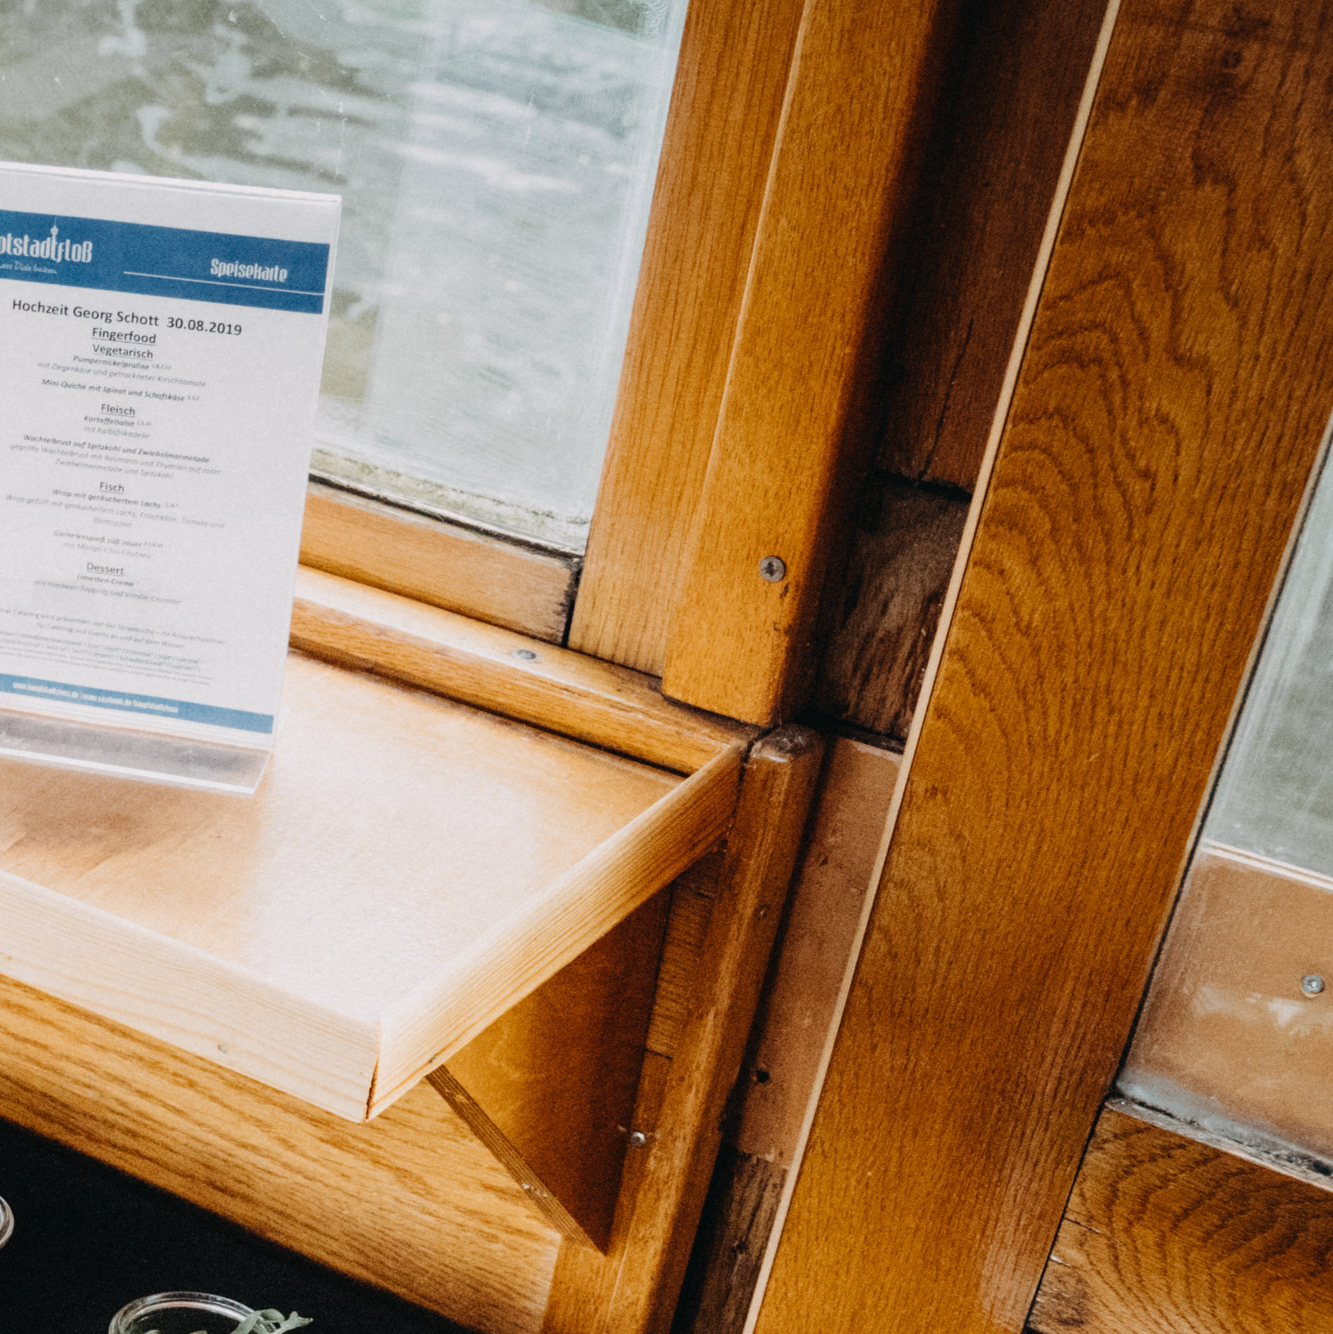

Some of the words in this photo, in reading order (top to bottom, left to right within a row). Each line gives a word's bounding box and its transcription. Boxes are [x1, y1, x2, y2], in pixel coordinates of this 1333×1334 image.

[210, 258, 288, 283] Speisekarte
[12, 298, 69, 317] Hochzeit
[72, 305, 113, 323] Georg
[116, 310, 160, 327] Schott
[166, 316, 243, 337] 30.08.2019
[91, 326, 157, 345] Fingerfood
[92, 343, 154, 359] Vegetarisch
[102, 386, 127, 395] Spinat
[100, 403, 136, 416] Fleisch
[83, 415, 135, 427] Kartoffelsalat
[121, 447, 137, 455] und
[99, 481, 125, 493] Fisch
[52, 488, 73, 498] Wrap
[140, 500, 161, 509] Lachs
[86, 561, 124, 576] Dessert
